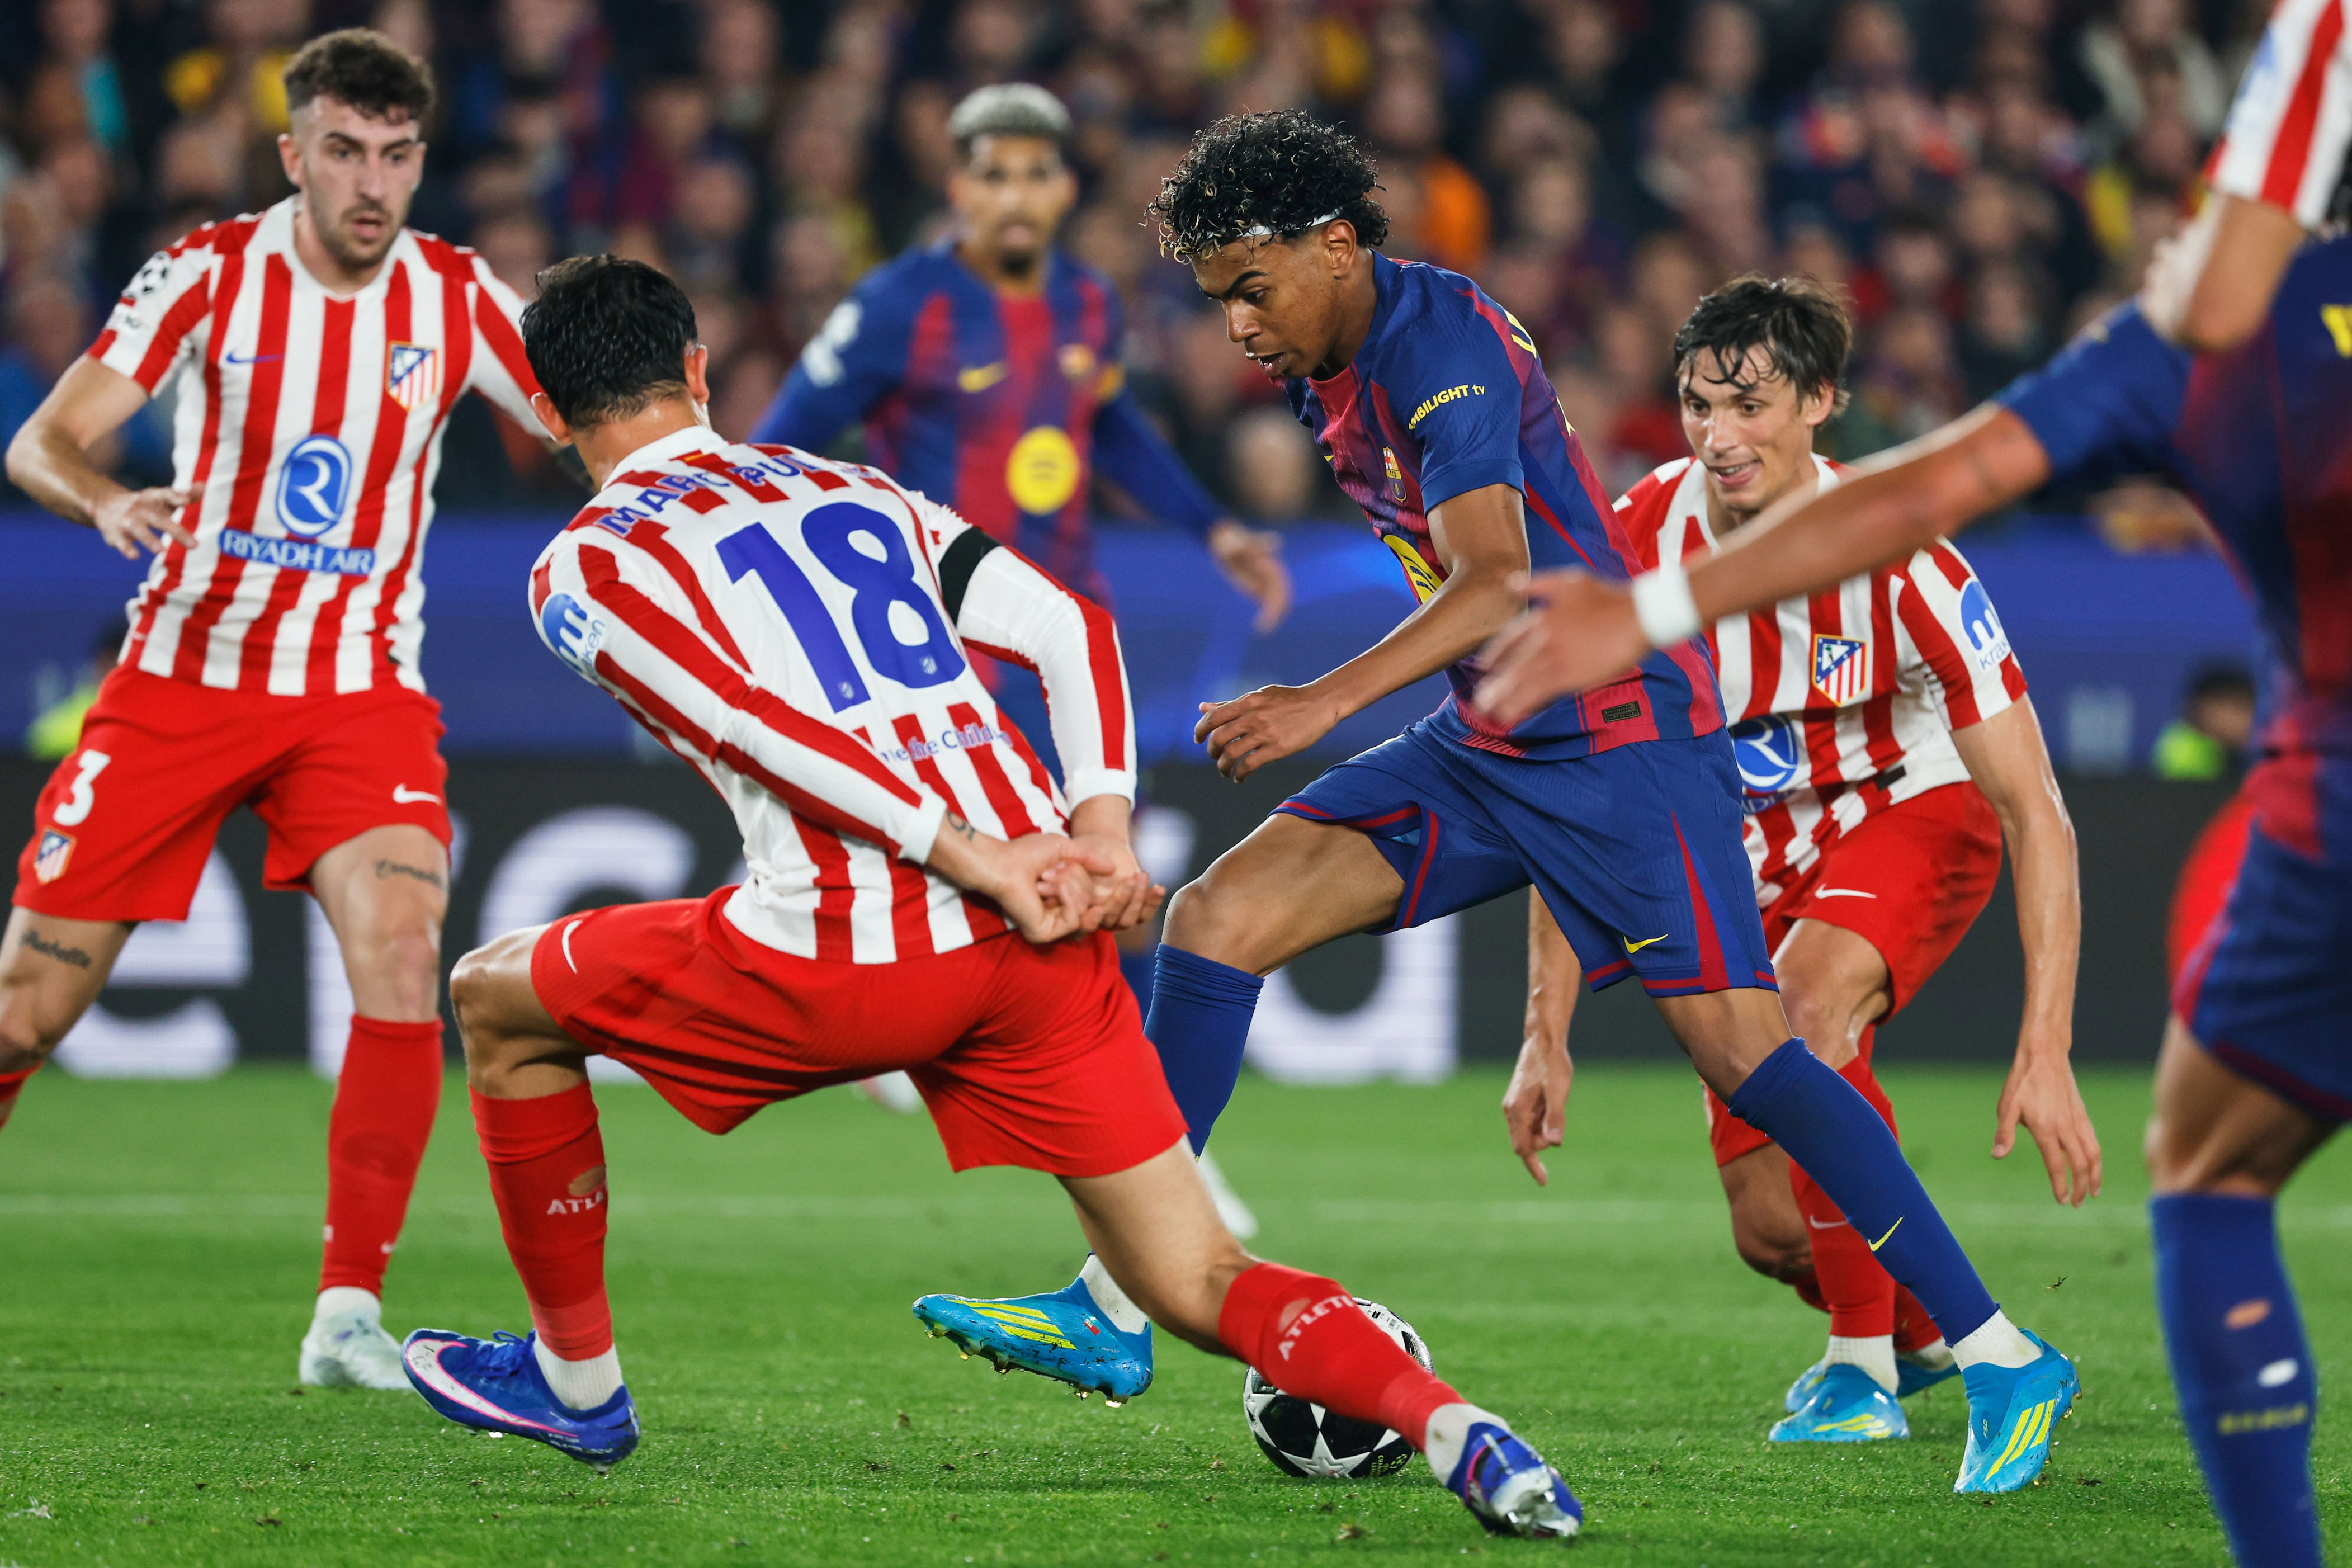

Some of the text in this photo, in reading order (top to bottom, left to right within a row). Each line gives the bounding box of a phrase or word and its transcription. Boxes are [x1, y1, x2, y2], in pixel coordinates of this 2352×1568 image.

[1472, 384, 1485, 395] tv
[223, 530, 372, 574] RIYADH AIR
[715, 502, 966, 714] 18
[908, 736, 939, 761] the
[53, 749, 111, 826] 3
